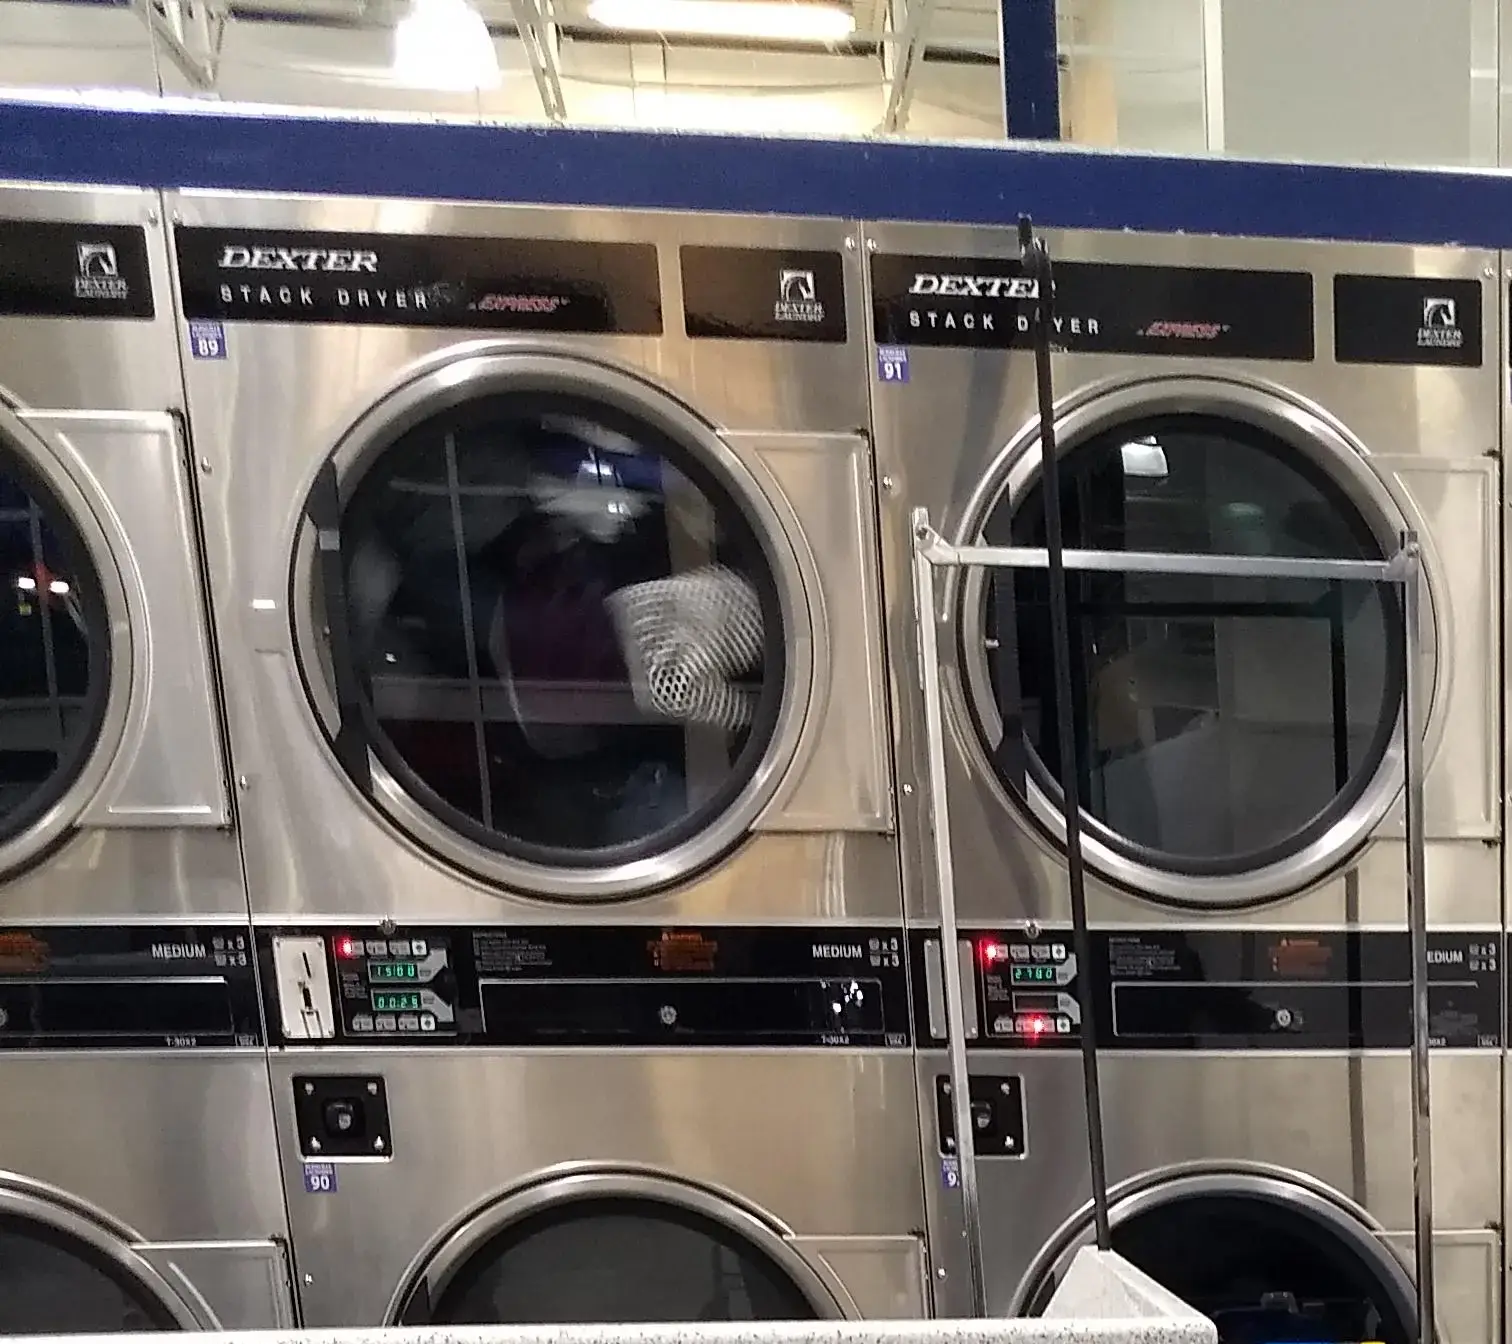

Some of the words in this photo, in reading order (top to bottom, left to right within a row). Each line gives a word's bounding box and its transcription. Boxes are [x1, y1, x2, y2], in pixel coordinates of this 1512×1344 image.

[218, 245, 378, 272] DEXTER
[220, 284, 312, 304] STACK
[338, 287, 428, 310] DRYER
[910, 310, 994, 330] STACK
[1018, 308, 1099, 335] DYER
[199, 339, 219, 356] 89
[884, 362, 902, 379] 91
[151, 943, 206, 958] MEDIUM
[812, 944, 863, 958] MEDIUM
[1427, 950, 1463, 964] EDIUM
[310, 1174, 331, 1191] 90
